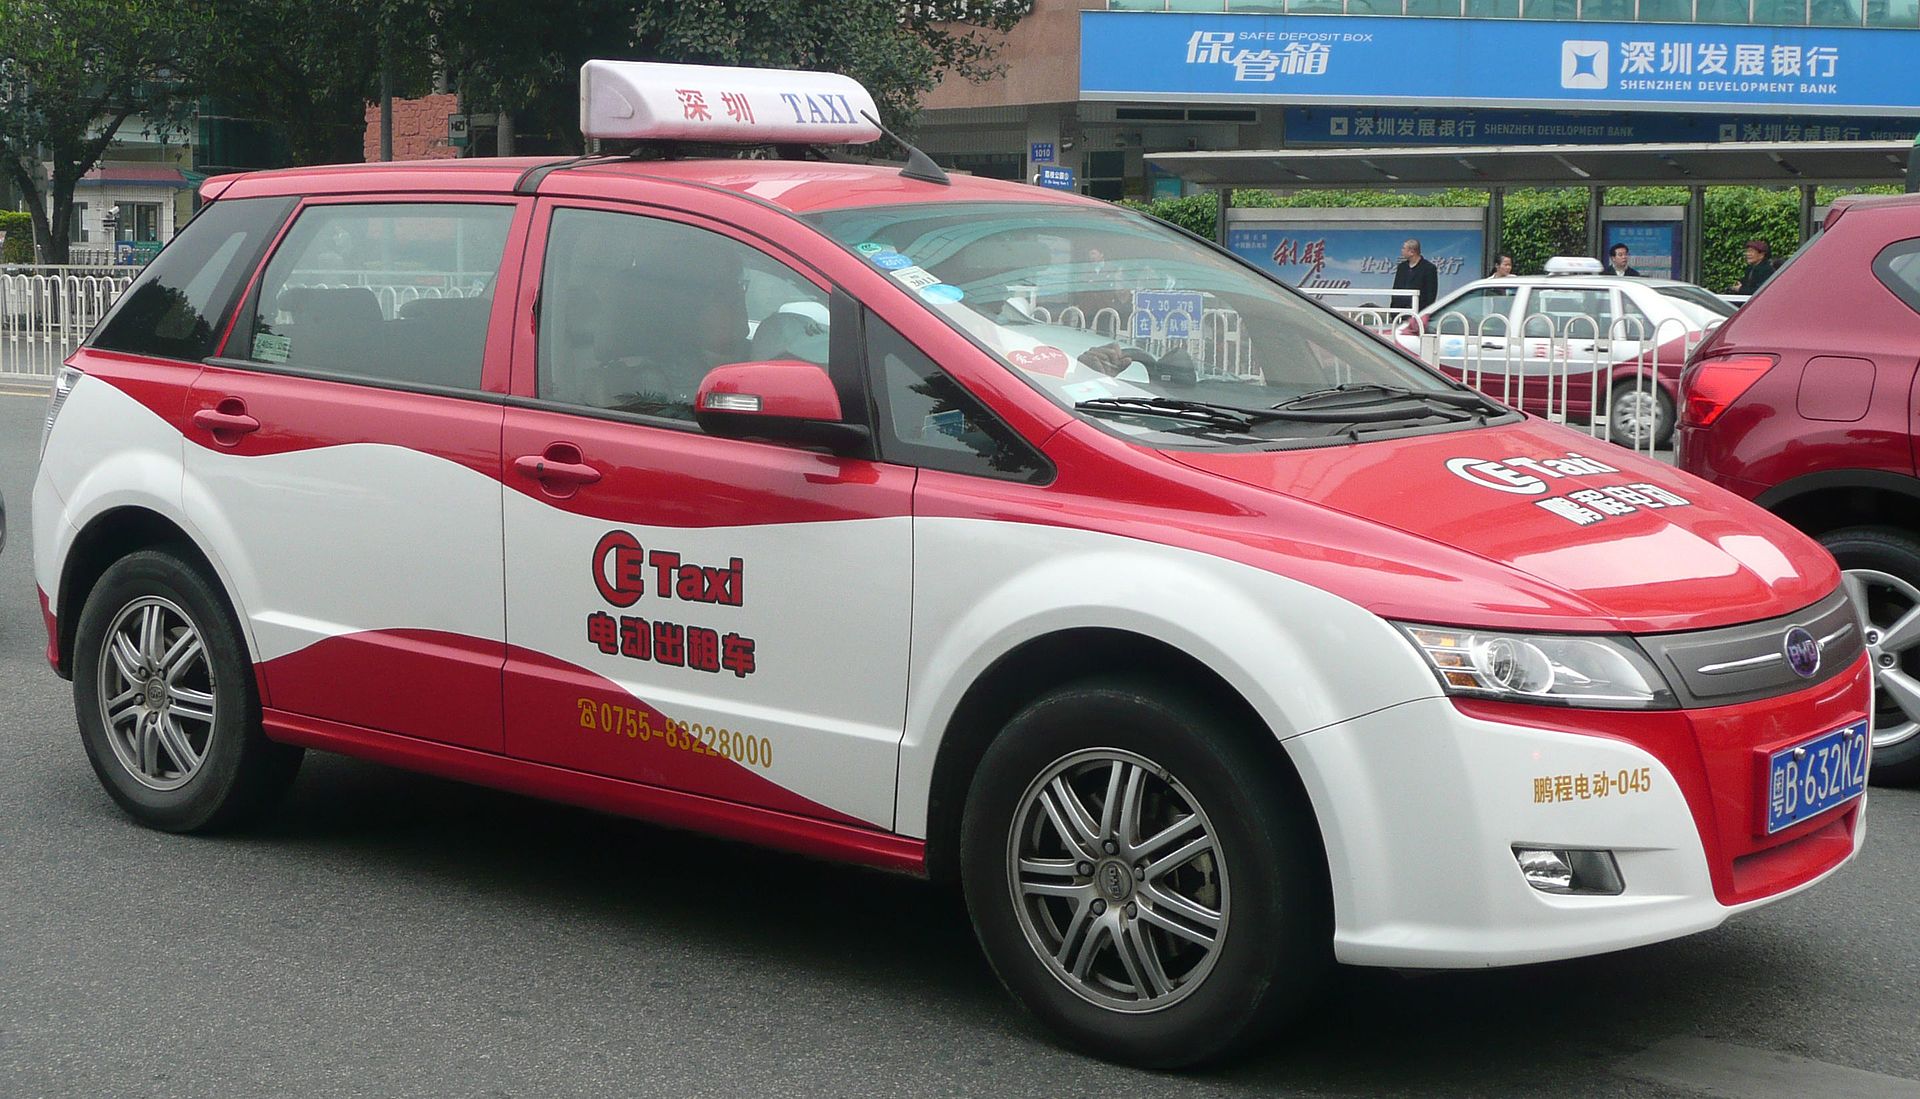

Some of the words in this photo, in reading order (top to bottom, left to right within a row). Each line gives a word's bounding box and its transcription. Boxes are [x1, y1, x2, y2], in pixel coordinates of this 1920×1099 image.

[1239, 31, 1276, 41] SAFE
[1279, 32, 1341, 42] DEPOSIT
[1343, 33, 1374, 42] BOX
[1186, 30, 1332, 82] 保管箱
[1619, 41, 1839, 77] 深圳发展银行
[1620, 79, 1692, 91] SHENZHEN
[1698, 81, 1794, 93] DEVELOPMENT
[1800, 83, 1838, 94] BANK
[675, 88, 756, 125] 深圳
[780, 92, 858, 124] TAXI
[1354, 117, 1477, 137] 深圳发展银行
[1484, 123, 1535, 135] SHENZHEN
[1538, 124, 1605, 137] DEVELOPMENT
[1608, 126, 1634, 137] BANK
[1870, 131, 1915, 141] SHENZHE
[1502, 452, 1621, 479] Taxi
[649, 549, 744, 607] Taxi
[587, 611, 756, 679] 电动出租车
[601, 703, 773, 768] 0755-83228000
[1533, 767, 1651, 803] 鹏程电动-045
